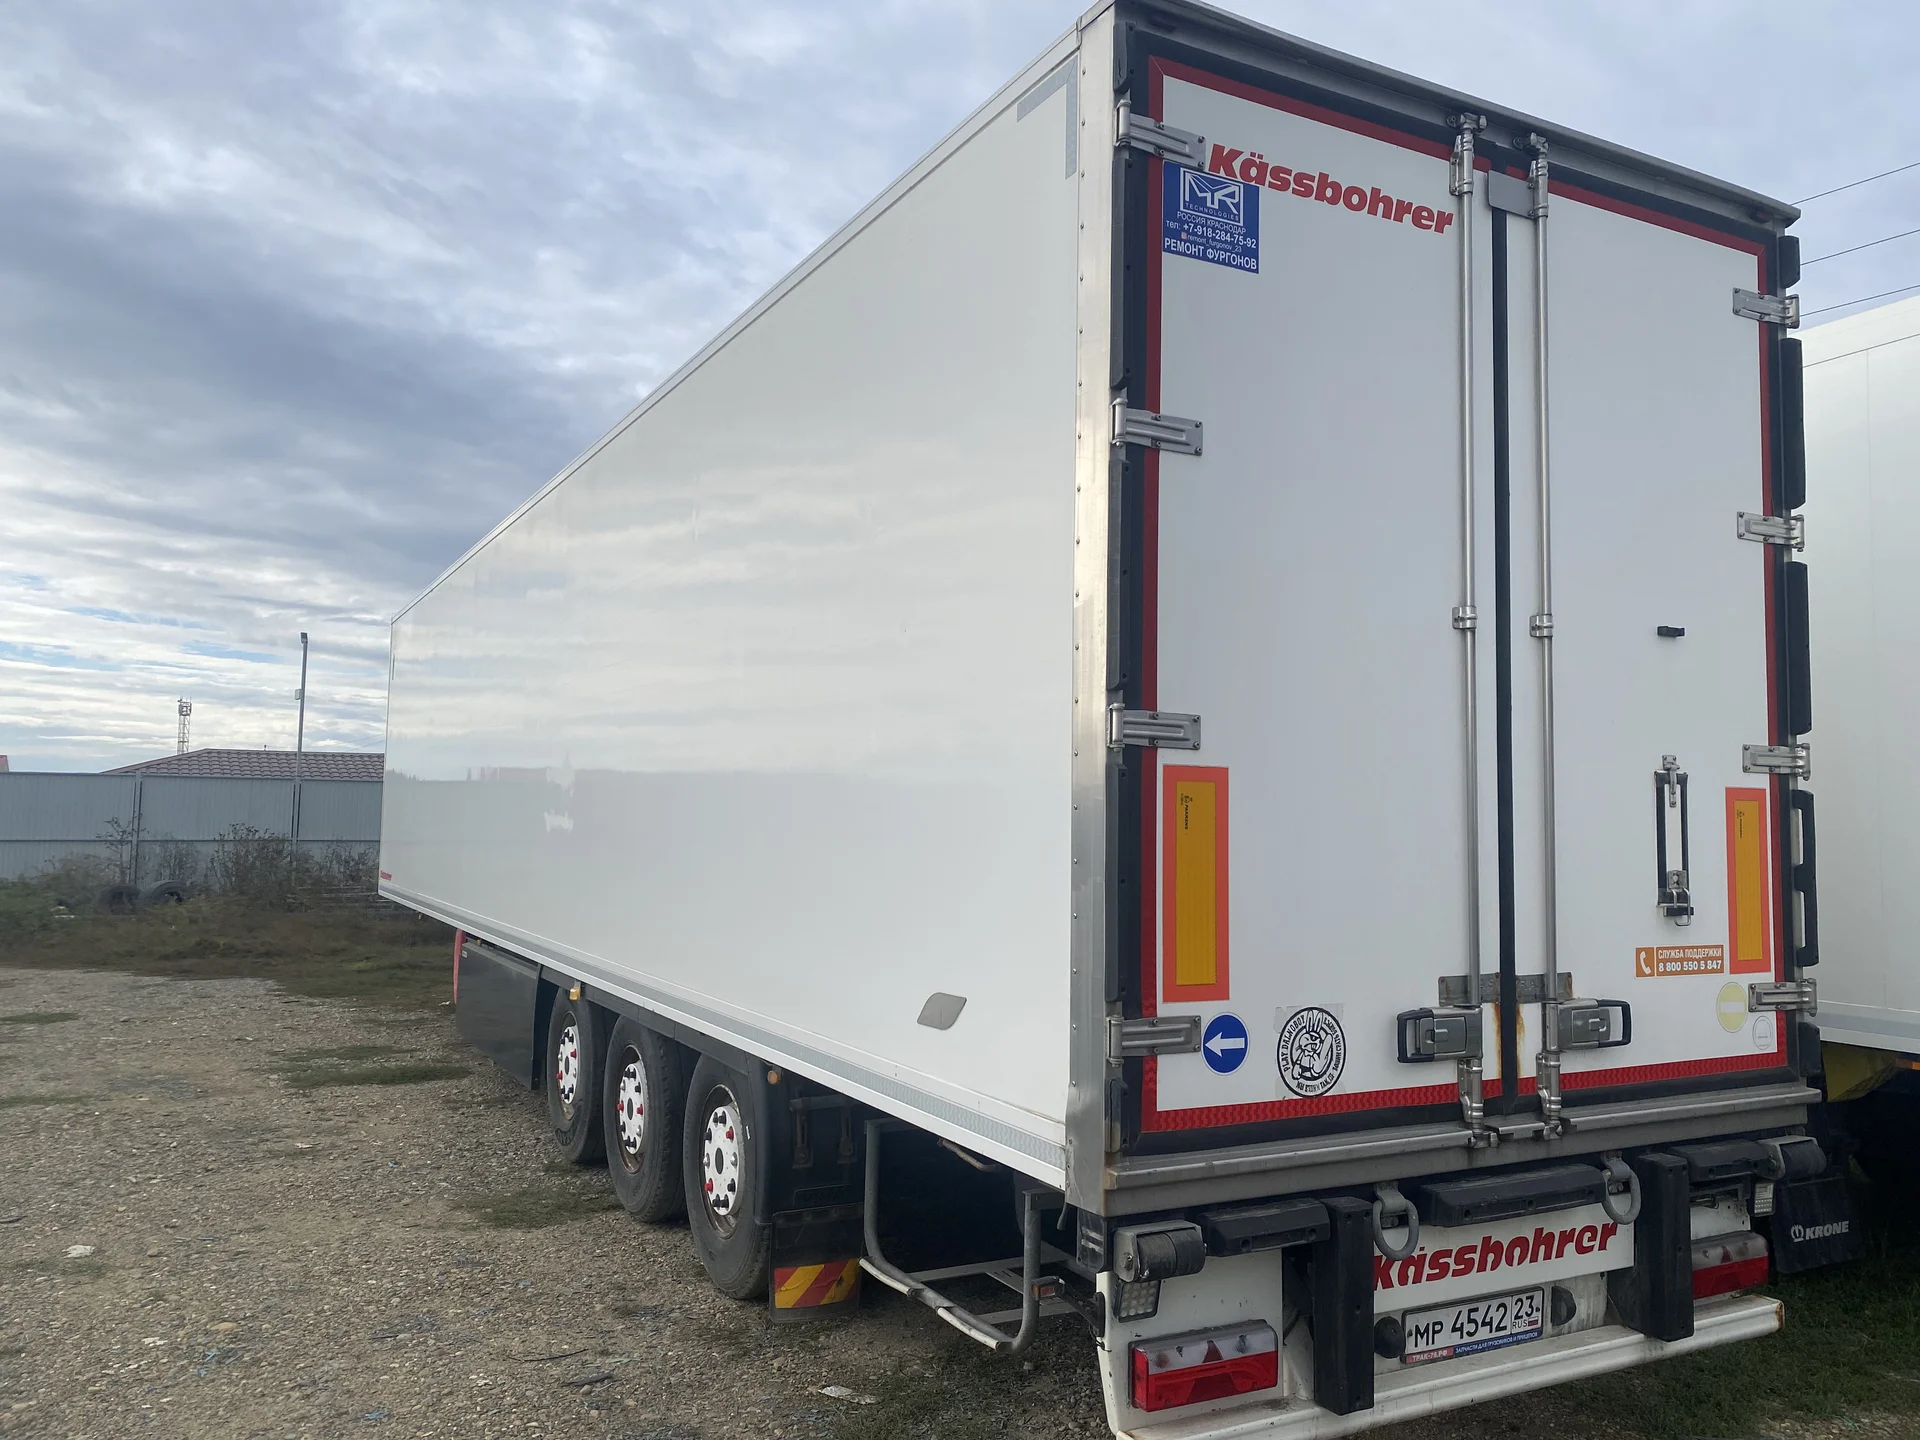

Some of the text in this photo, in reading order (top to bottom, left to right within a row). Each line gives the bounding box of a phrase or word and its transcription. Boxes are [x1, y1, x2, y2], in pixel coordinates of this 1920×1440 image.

[1208, 143, 1455, 234] Kässbohrer
[1185, 202, 1240, 221] TECHNOLOGIES
[1177, 211, 1246, 235] РОССИЯ КРАСНОДАР
[1166, 220, 1257, 249] тел: +7-918-284-75-92
[1164, 237, 1257, 270] РЕМОНТ ФУРГОНОВ
[1658, 948, 1722, 959] СЛУЖБА ПОДДЕРЖКИ
[1658, 960, 1722, 972] 8 800 550 5 847
[1281, 1052, 1290, 1072] PLAY
[1805, 1221, 1849, 1240] KRONE
[1451, 1303, 1508, 1340] 4542
[1514, 1295, 1535, 1321] 23
[1513, 1319, 1528, 1330] RUS
